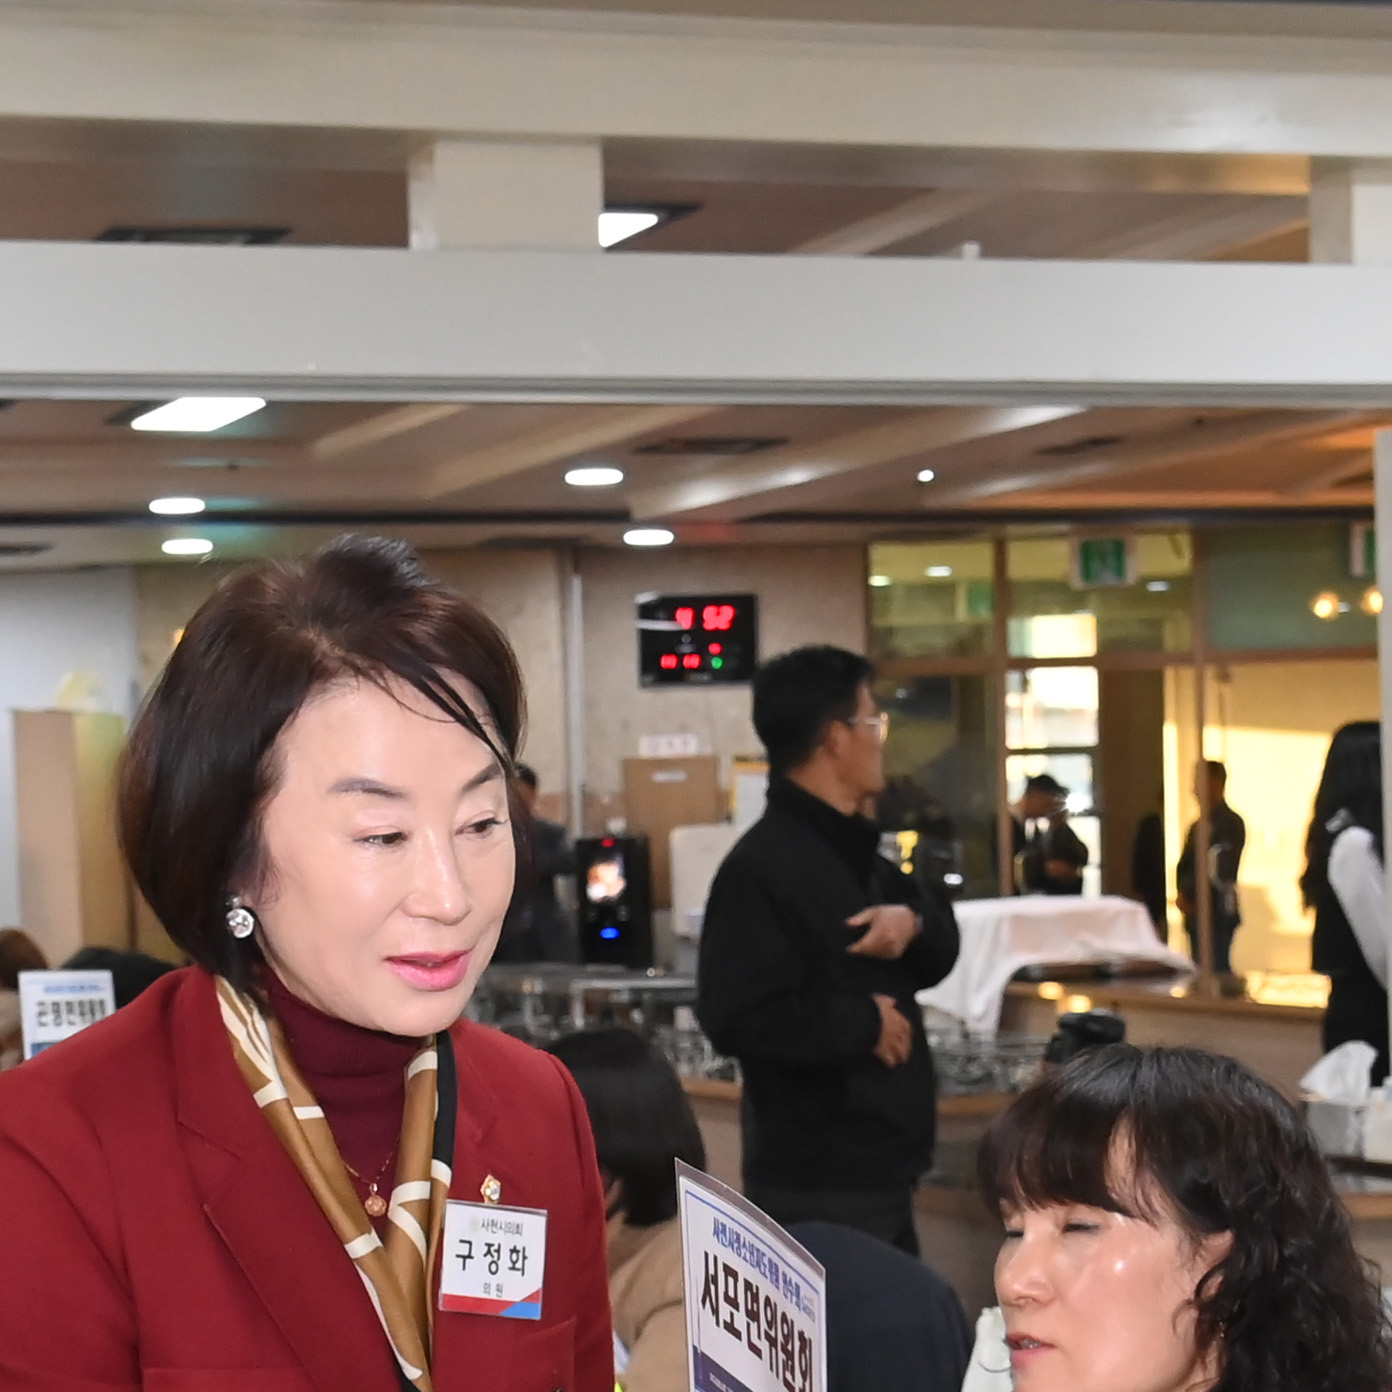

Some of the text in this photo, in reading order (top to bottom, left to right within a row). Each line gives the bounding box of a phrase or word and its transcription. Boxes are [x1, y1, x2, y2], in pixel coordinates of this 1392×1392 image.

[480, 1218, 523, 1237] 사천시의회
[455, 1239, 528, 1277] 구정화
[483, 1282, 504, 1298] 의원
